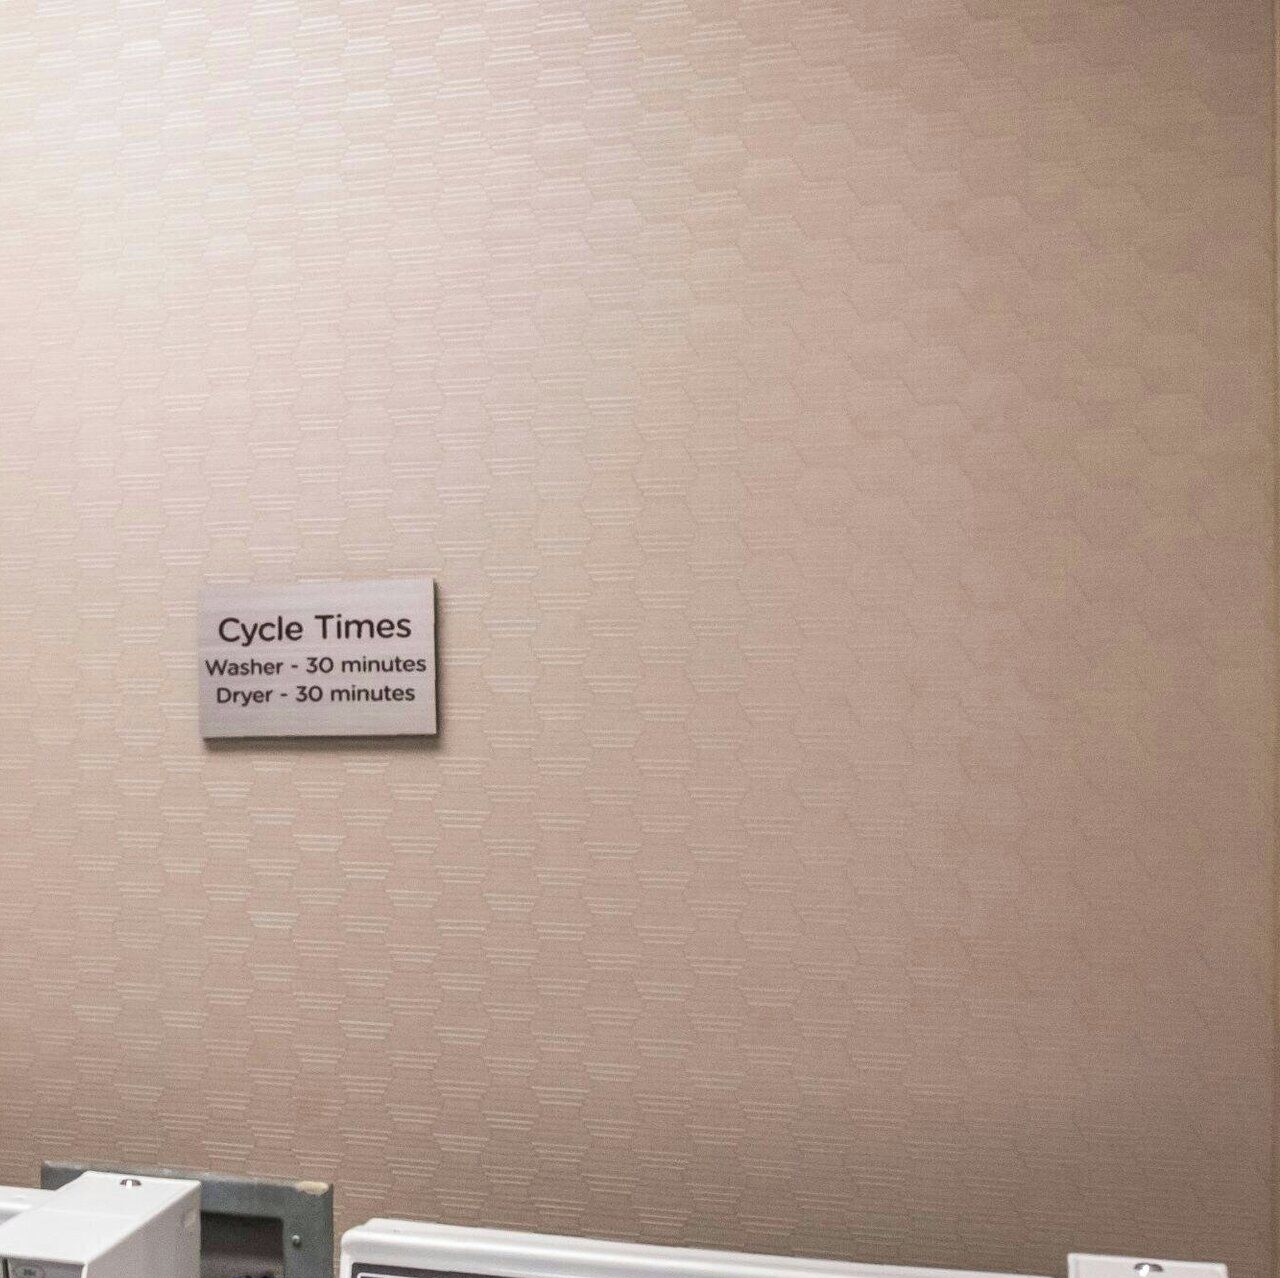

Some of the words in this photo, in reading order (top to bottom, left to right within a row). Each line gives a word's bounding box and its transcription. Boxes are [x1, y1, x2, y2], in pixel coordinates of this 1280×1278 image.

[219, 616, 303, 647] Cycle
[315, 614, 411, 639] Times
[205, 659, 283, 676] Washer
[306, 657, 334, 674] 30
[342, 656, 426, 673] minutes
[217, 687, 273, 707] Dryer
[296, 685, 323, 702] 30
[331, 685, 415, 702] minutes
